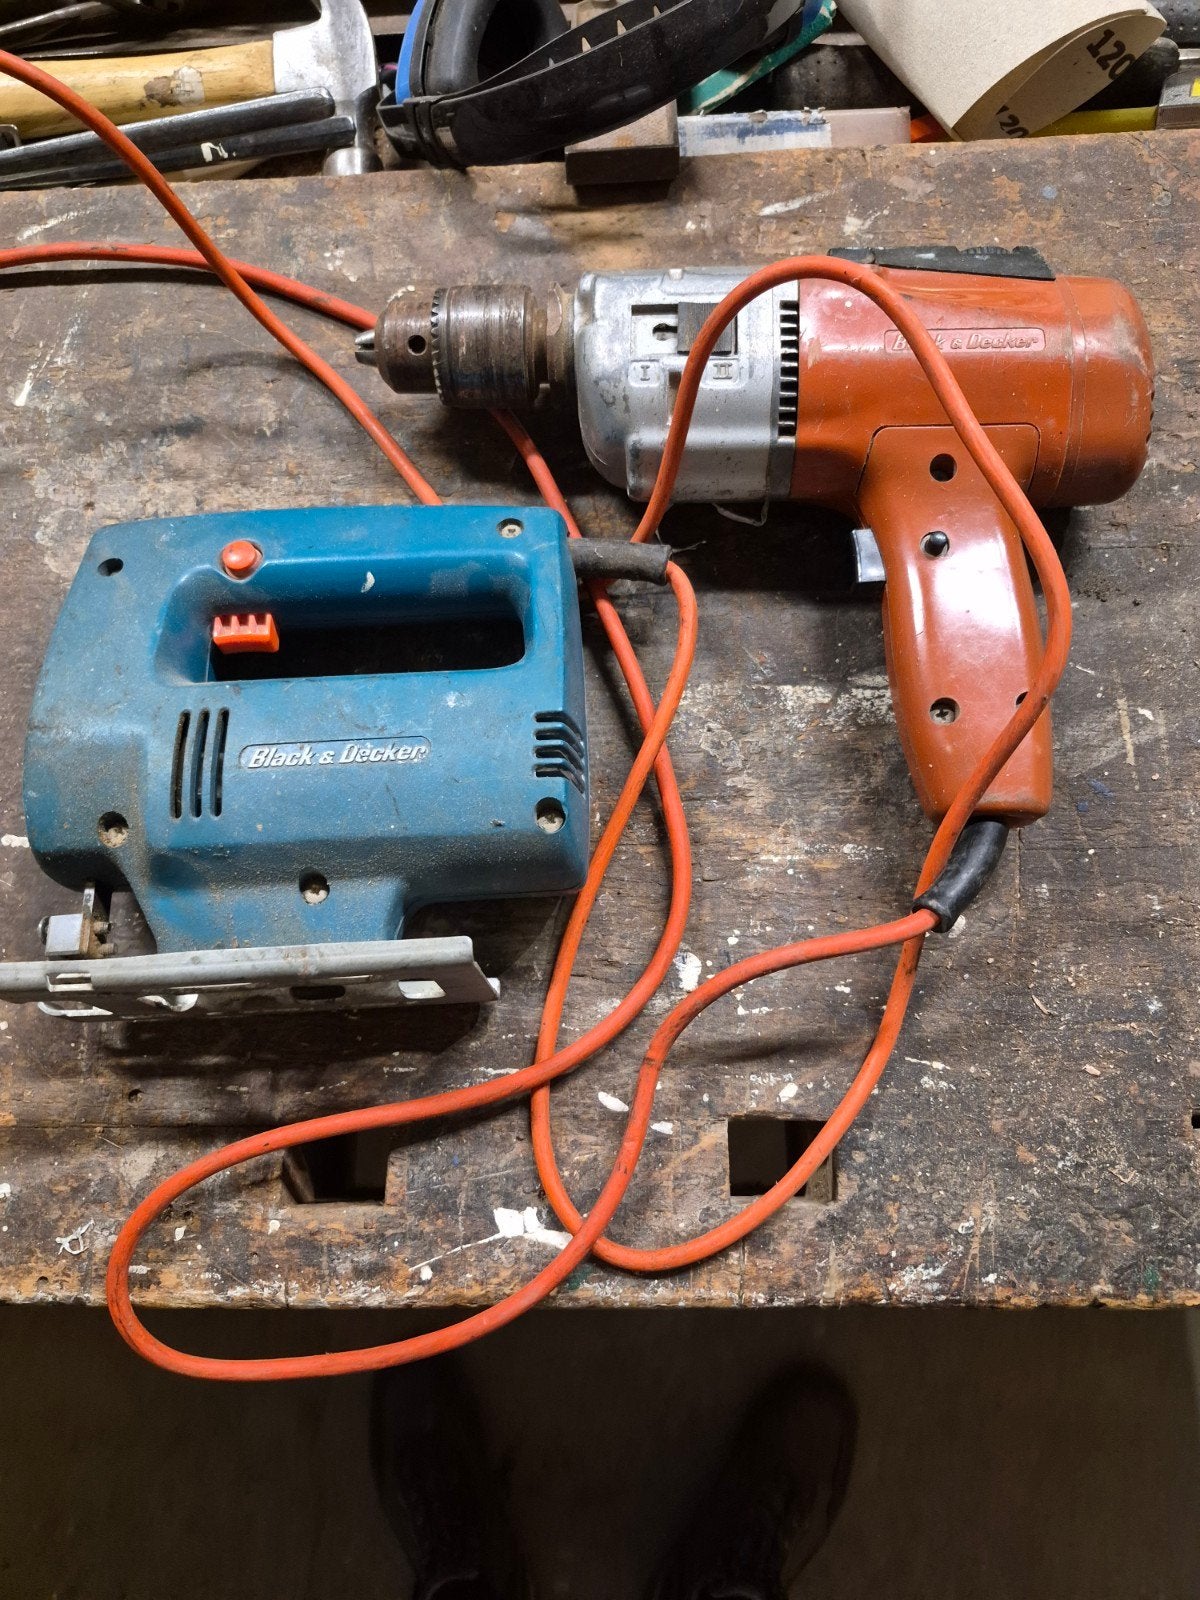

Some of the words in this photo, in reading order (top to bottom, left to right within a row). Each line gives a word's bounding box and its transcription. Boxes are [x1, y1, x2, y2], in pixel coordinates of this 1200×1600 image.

[1086, 29, 1135, 80] 120
[966, 332, 1039, 350] Decker
[247, 743, 316, 769] Black
[319, 750, 335, 766] &
[339, 742, 428, 764] Decker
